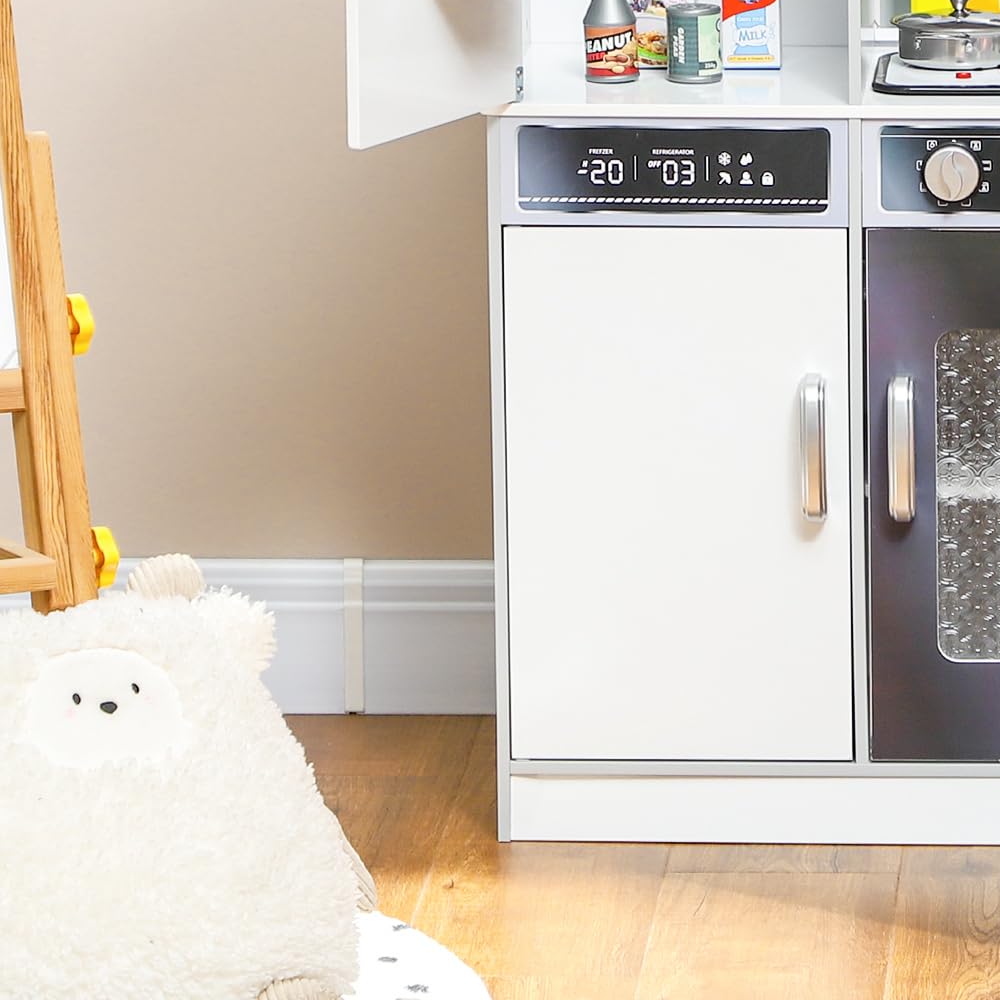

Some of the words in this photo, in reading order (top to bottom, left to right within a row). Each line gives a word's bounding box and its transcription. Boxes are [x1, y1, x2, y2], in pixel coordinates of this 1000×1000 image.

[586, 30, 632, 54] EANUT
[647, 160, 662, 169] OFF
[662, 159, 695, 185] 03
